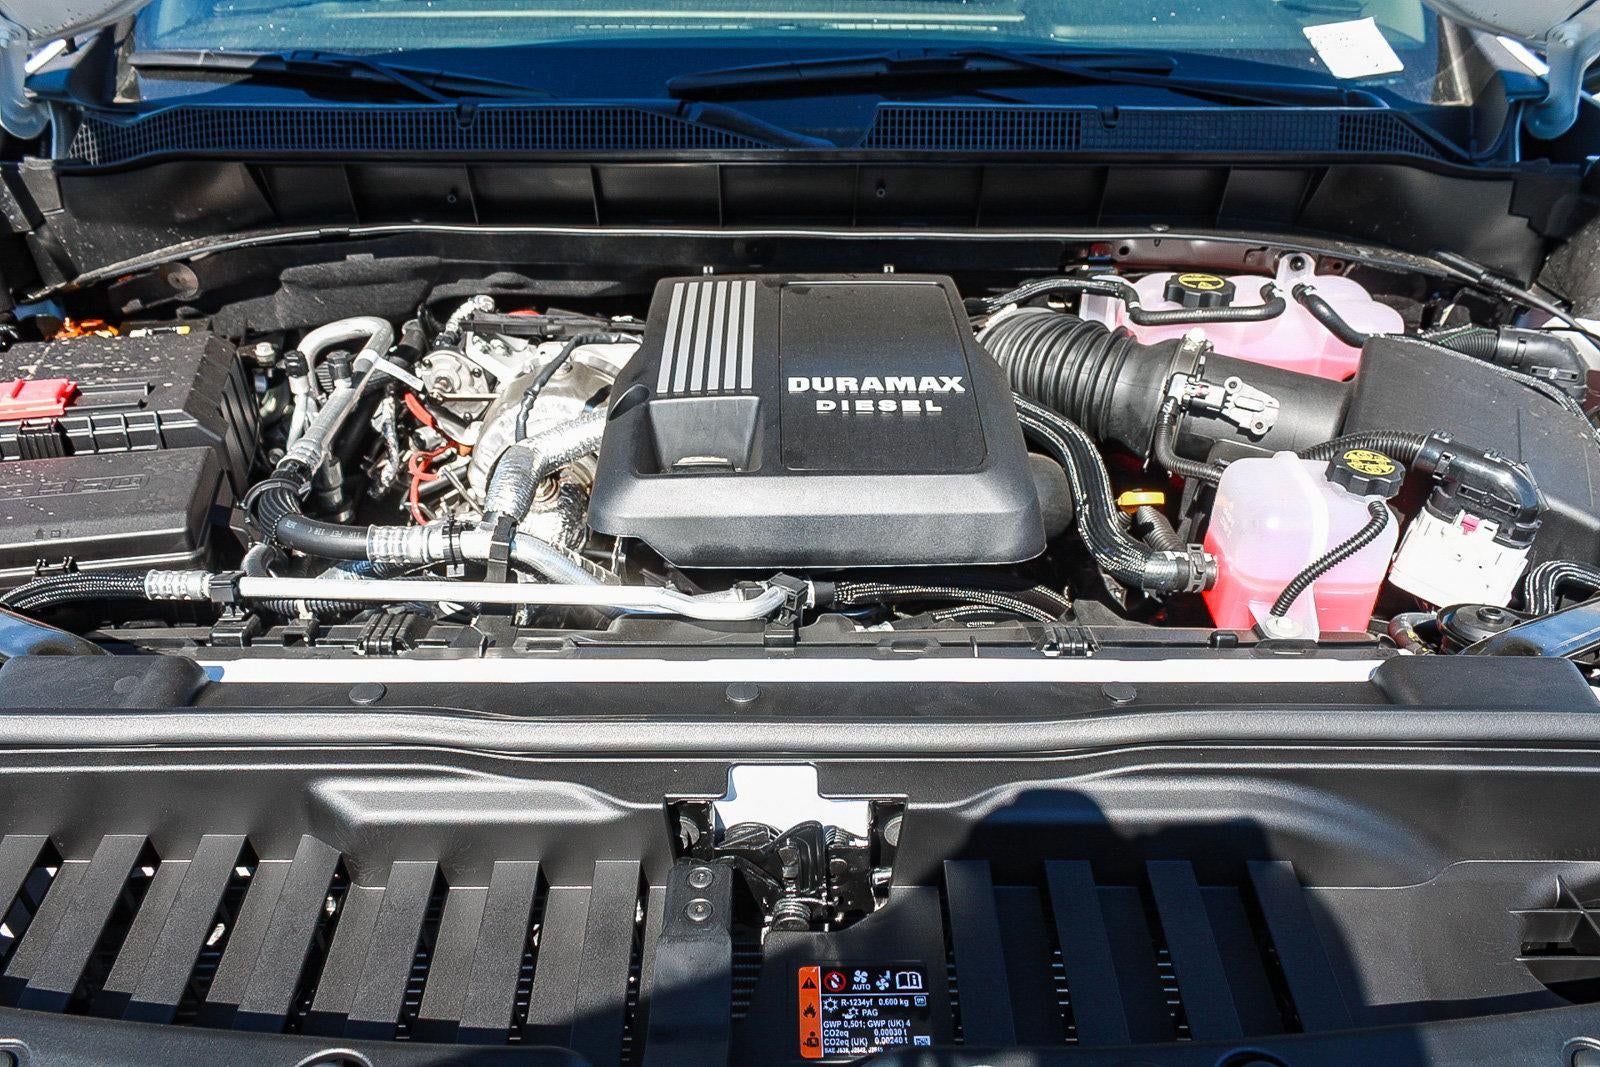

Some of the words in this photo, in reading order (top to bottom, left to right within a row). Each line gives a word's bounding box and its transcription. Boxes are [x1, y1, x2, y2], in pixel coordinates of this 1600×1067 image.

[788, 376, 965, 393] DURAMAX
[816, 400, 942, 413] DIESEL
[841, 998, 873, 1007] R-1234yf
[878, 998, 898, 1006] 0.600
[900, 998, 909, 1007] kg
[888, 1020, 904, 1028] (UK)
[824, 1029, 848, 1038] CO2eq
[824, 1038, 850, 1047] CO2eq
[851, 1037, 868, 1047] (UK)
